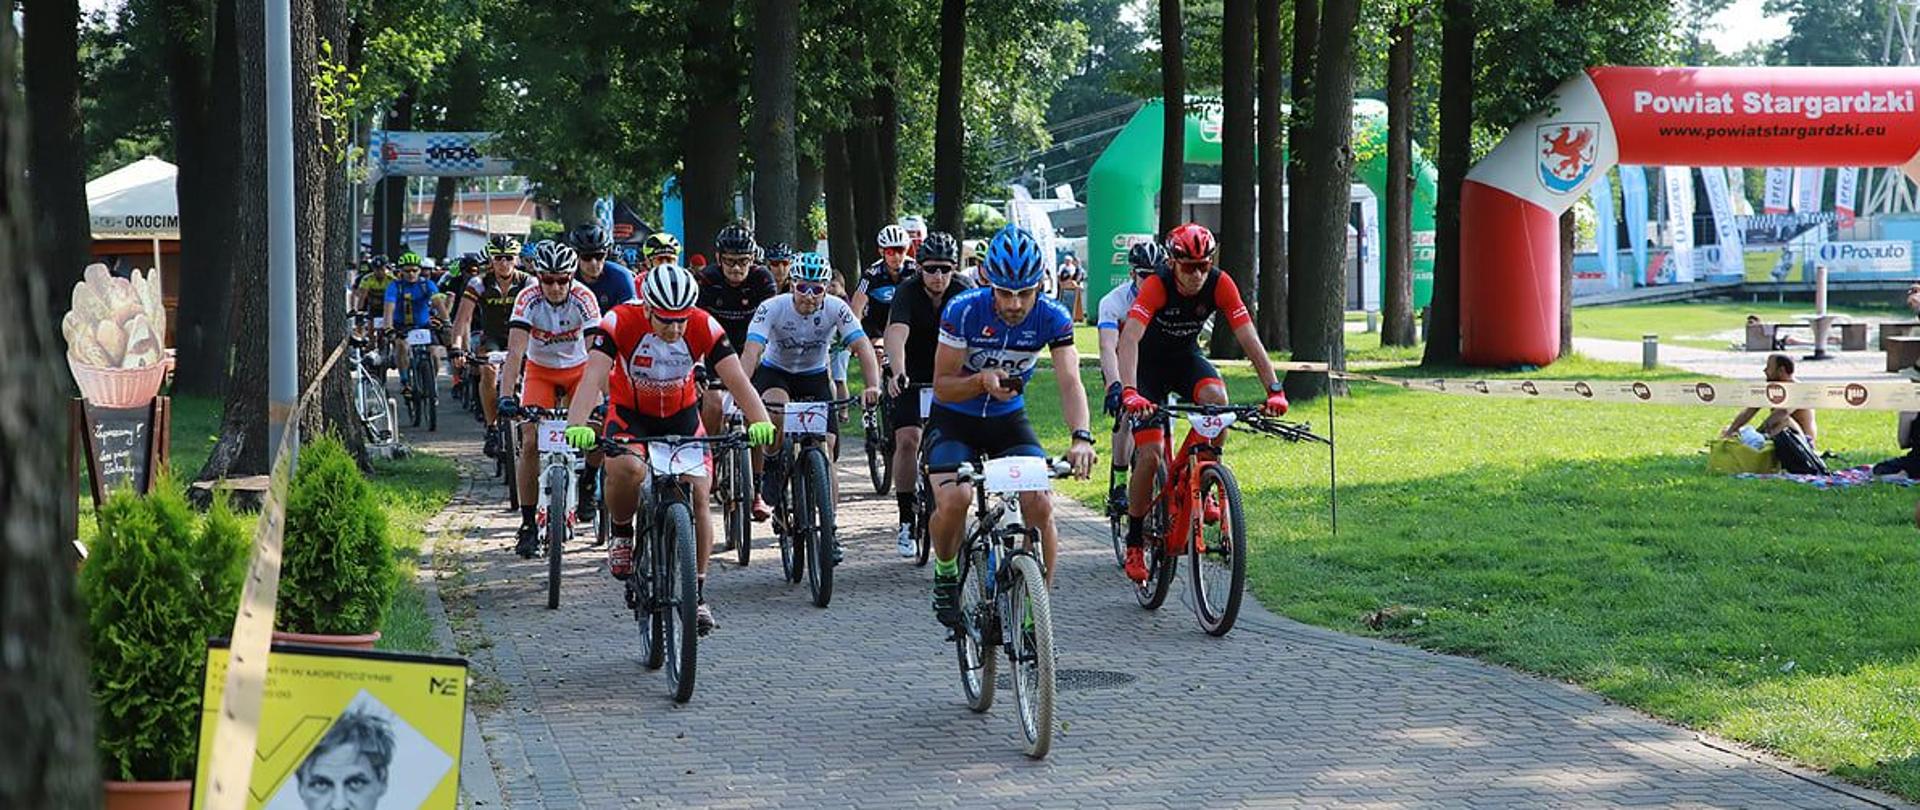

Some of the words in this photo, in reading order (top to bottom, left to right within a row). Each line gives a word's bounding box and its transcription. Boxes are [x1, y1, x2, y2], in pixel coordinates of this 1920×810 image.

[1634, 91, 1734, 114] Powiat
[1742, 90, 1915, 119] Stargardzki
[1659, 123, 1886, 140] www.powiatstargardzki.eu
[125, 215, 178, 228] OKOCIM
[1841, 244, 1904, 259] Proauto
[1202, 416, 1222, 428] 34
[549, 431, 566, 442] 27
[1009, 465, 1021, 479] 5
